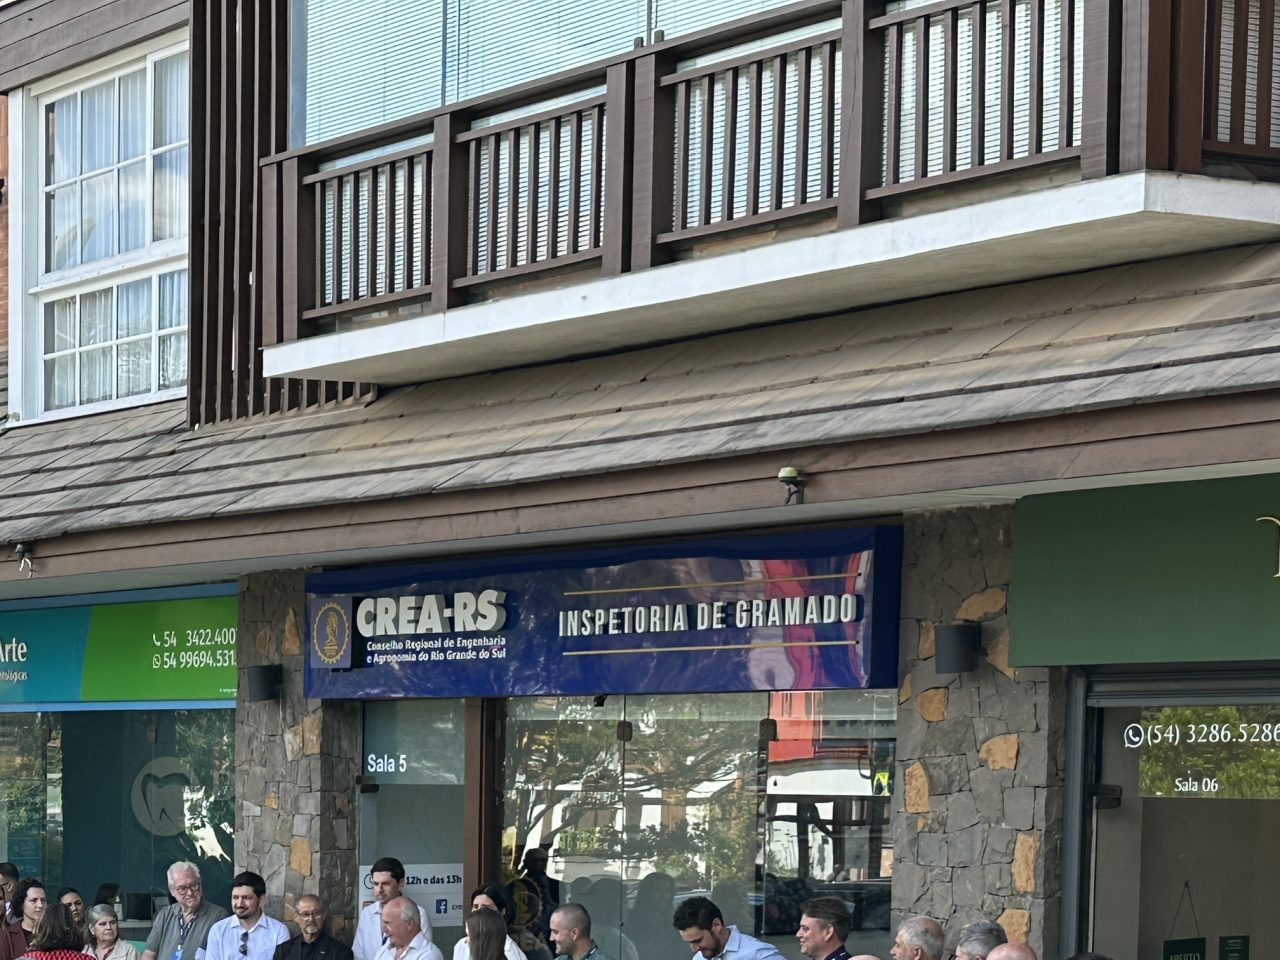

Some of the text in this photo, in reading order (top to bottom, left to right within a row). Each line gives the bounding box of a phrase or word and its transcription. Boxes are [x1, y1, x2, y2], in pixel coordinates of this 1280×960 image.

[356, 590, 503, 637] CREA-RS
[559, 594, 854, 637] INSPETORIA DE GRAMADO
[163, 627, 238, 647] 54 3422.400
[367, 635, 506, 651] Conselho Regional de Engenharia
[163, 649, 237, 669] 54 99694.531
[431, 650, 444, 661] Rio
[447, 650, 477, 660] Grande
[479, 649, 490, 659] do
[492, 648, 506, 659] Sul
[1147, 724, 1180, 746] (54)
[367, 754, 407, 772] Sala 5
[1174, 777, 1218, 792] Sala 06
[430, 876, 444, 884] das
